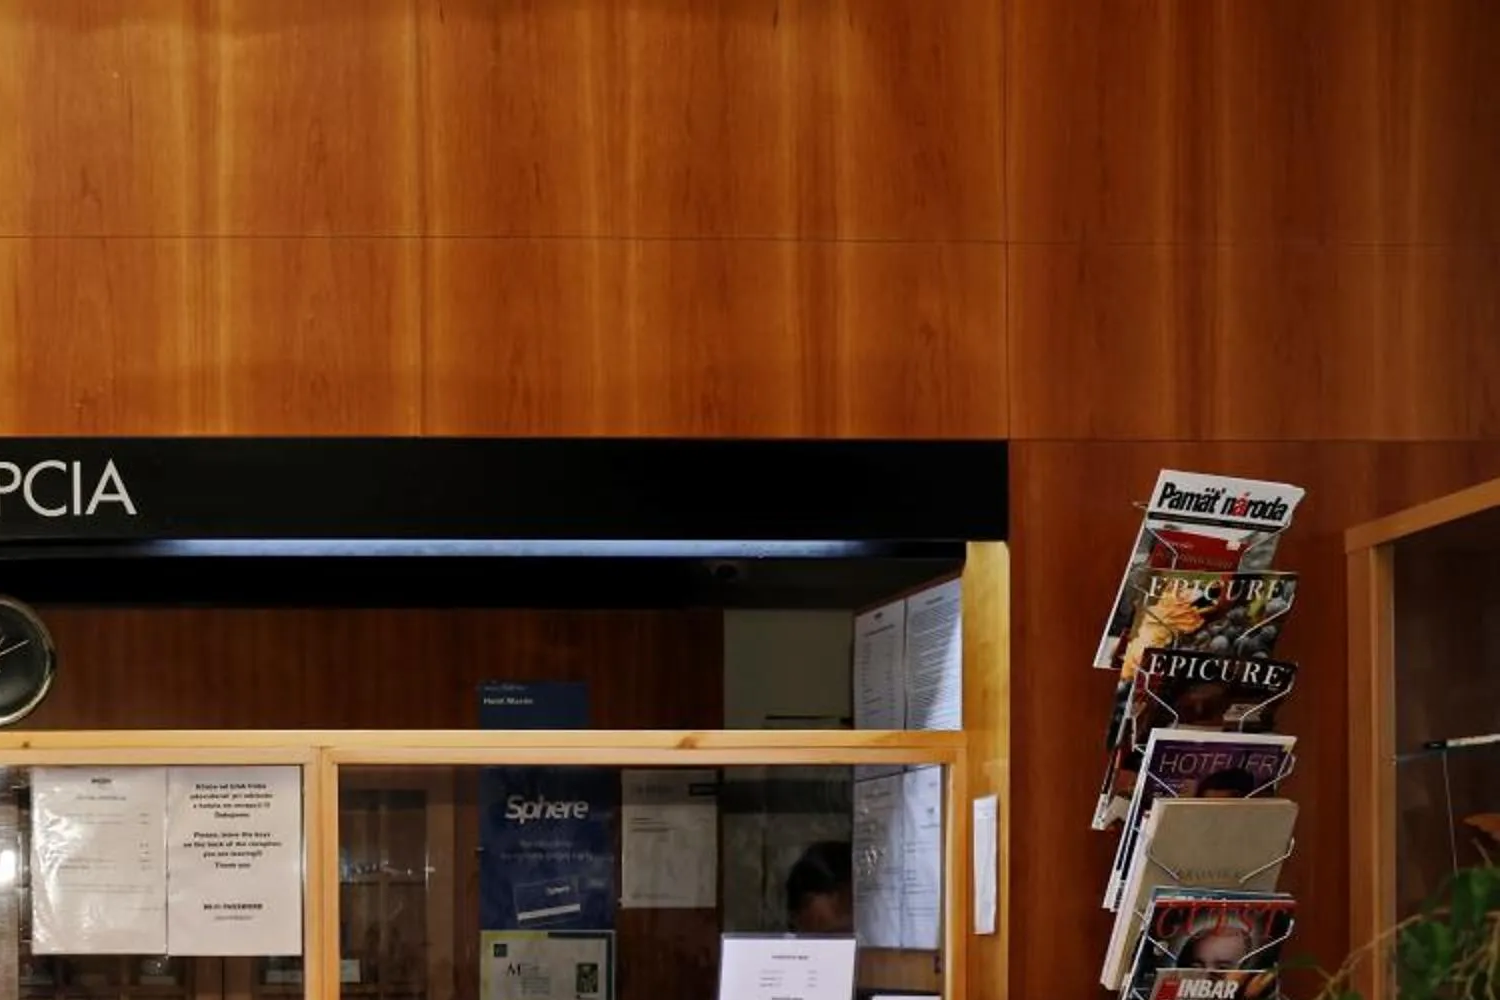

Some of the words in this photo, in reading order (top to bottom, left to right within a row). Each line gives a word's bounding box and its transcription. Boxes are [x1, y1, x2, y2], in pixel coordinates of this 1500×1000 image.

[1149, 576, 1286, 601] EPICURE
[1150, 653, 1285, 690] EPICURE
[505, 794, 589, 825] Sphere
